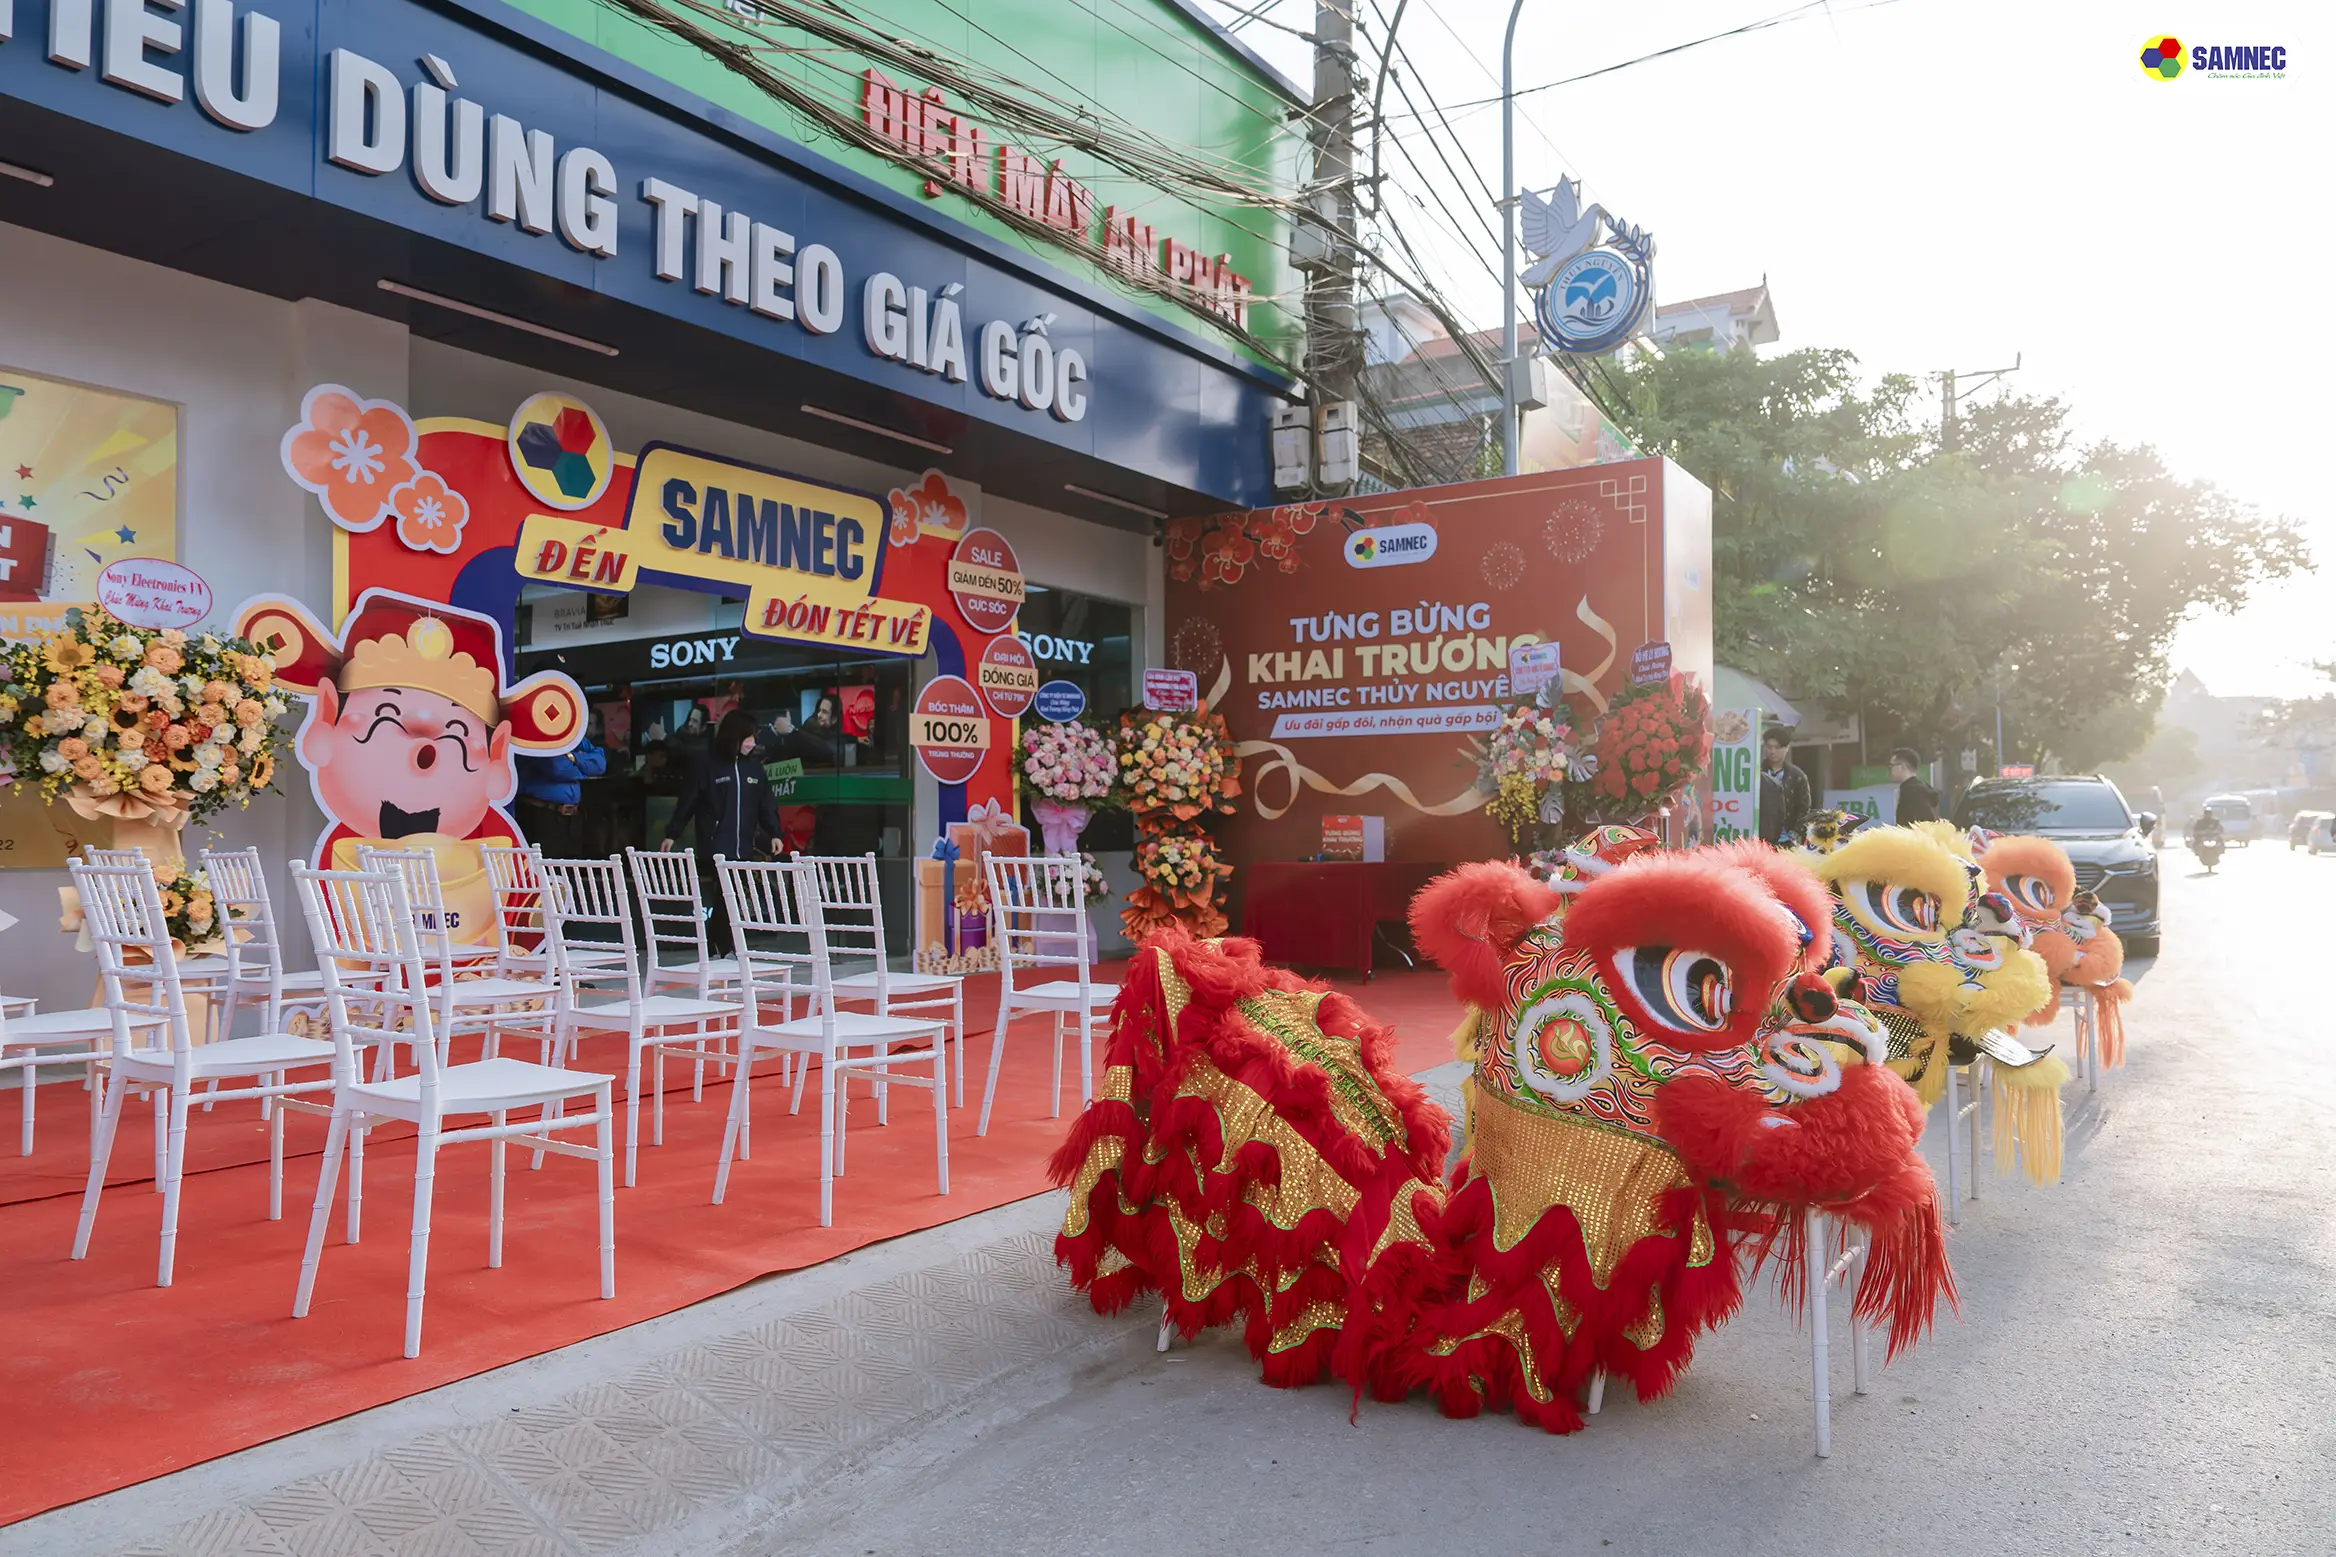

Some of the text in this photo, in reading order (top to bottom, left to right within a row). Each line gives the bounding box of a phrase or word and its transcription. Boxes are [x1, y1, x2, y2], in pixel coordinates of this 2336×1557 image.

[861, 68, 987, 198] ĐIỆN
[1104, 205, 1158, 277] AN
[1164, 238, 1251, 332] PHÁT
[329, 47, 618, 258] DÙNG
[643, 177, 844, 334] THEO
[863, 271, 968, 382] GIÁ
[980, 312, 1087, 422] GỐC
[660, 477, 864, 581] SAMNEC
[1379, 535, 1428, 554] SAMNEC
[534, 527, 628, 584] ĐẾN
[971, 546, 1003, 568] SALE
[106, 569, 128, 588] Sony
[132, 572, 187, 594] Electronics
[978, 573, 997, 590] ĐẾN
[997, 576, 1023, 596] 50%
[761, 594, 926, 647] ĐÓN TẾT VỀ
[1290, 600, 1490, 643] TƯNG BỪNG
[651, 636, 740, 668] SONY
[1018, 631, 1095, 664] SONY
[1016, 672, 1035, 688] GIÁ
[1249, 647, 1343, 684] KHAI
[1258, 674, 1513, 709] SAMNEC THỦY NGUYÊ
[924, 720, 978, 744] 100%
[1285, 710, 1498, 733] Ưu đãi gấp đôi, nhận quà gấp bội
